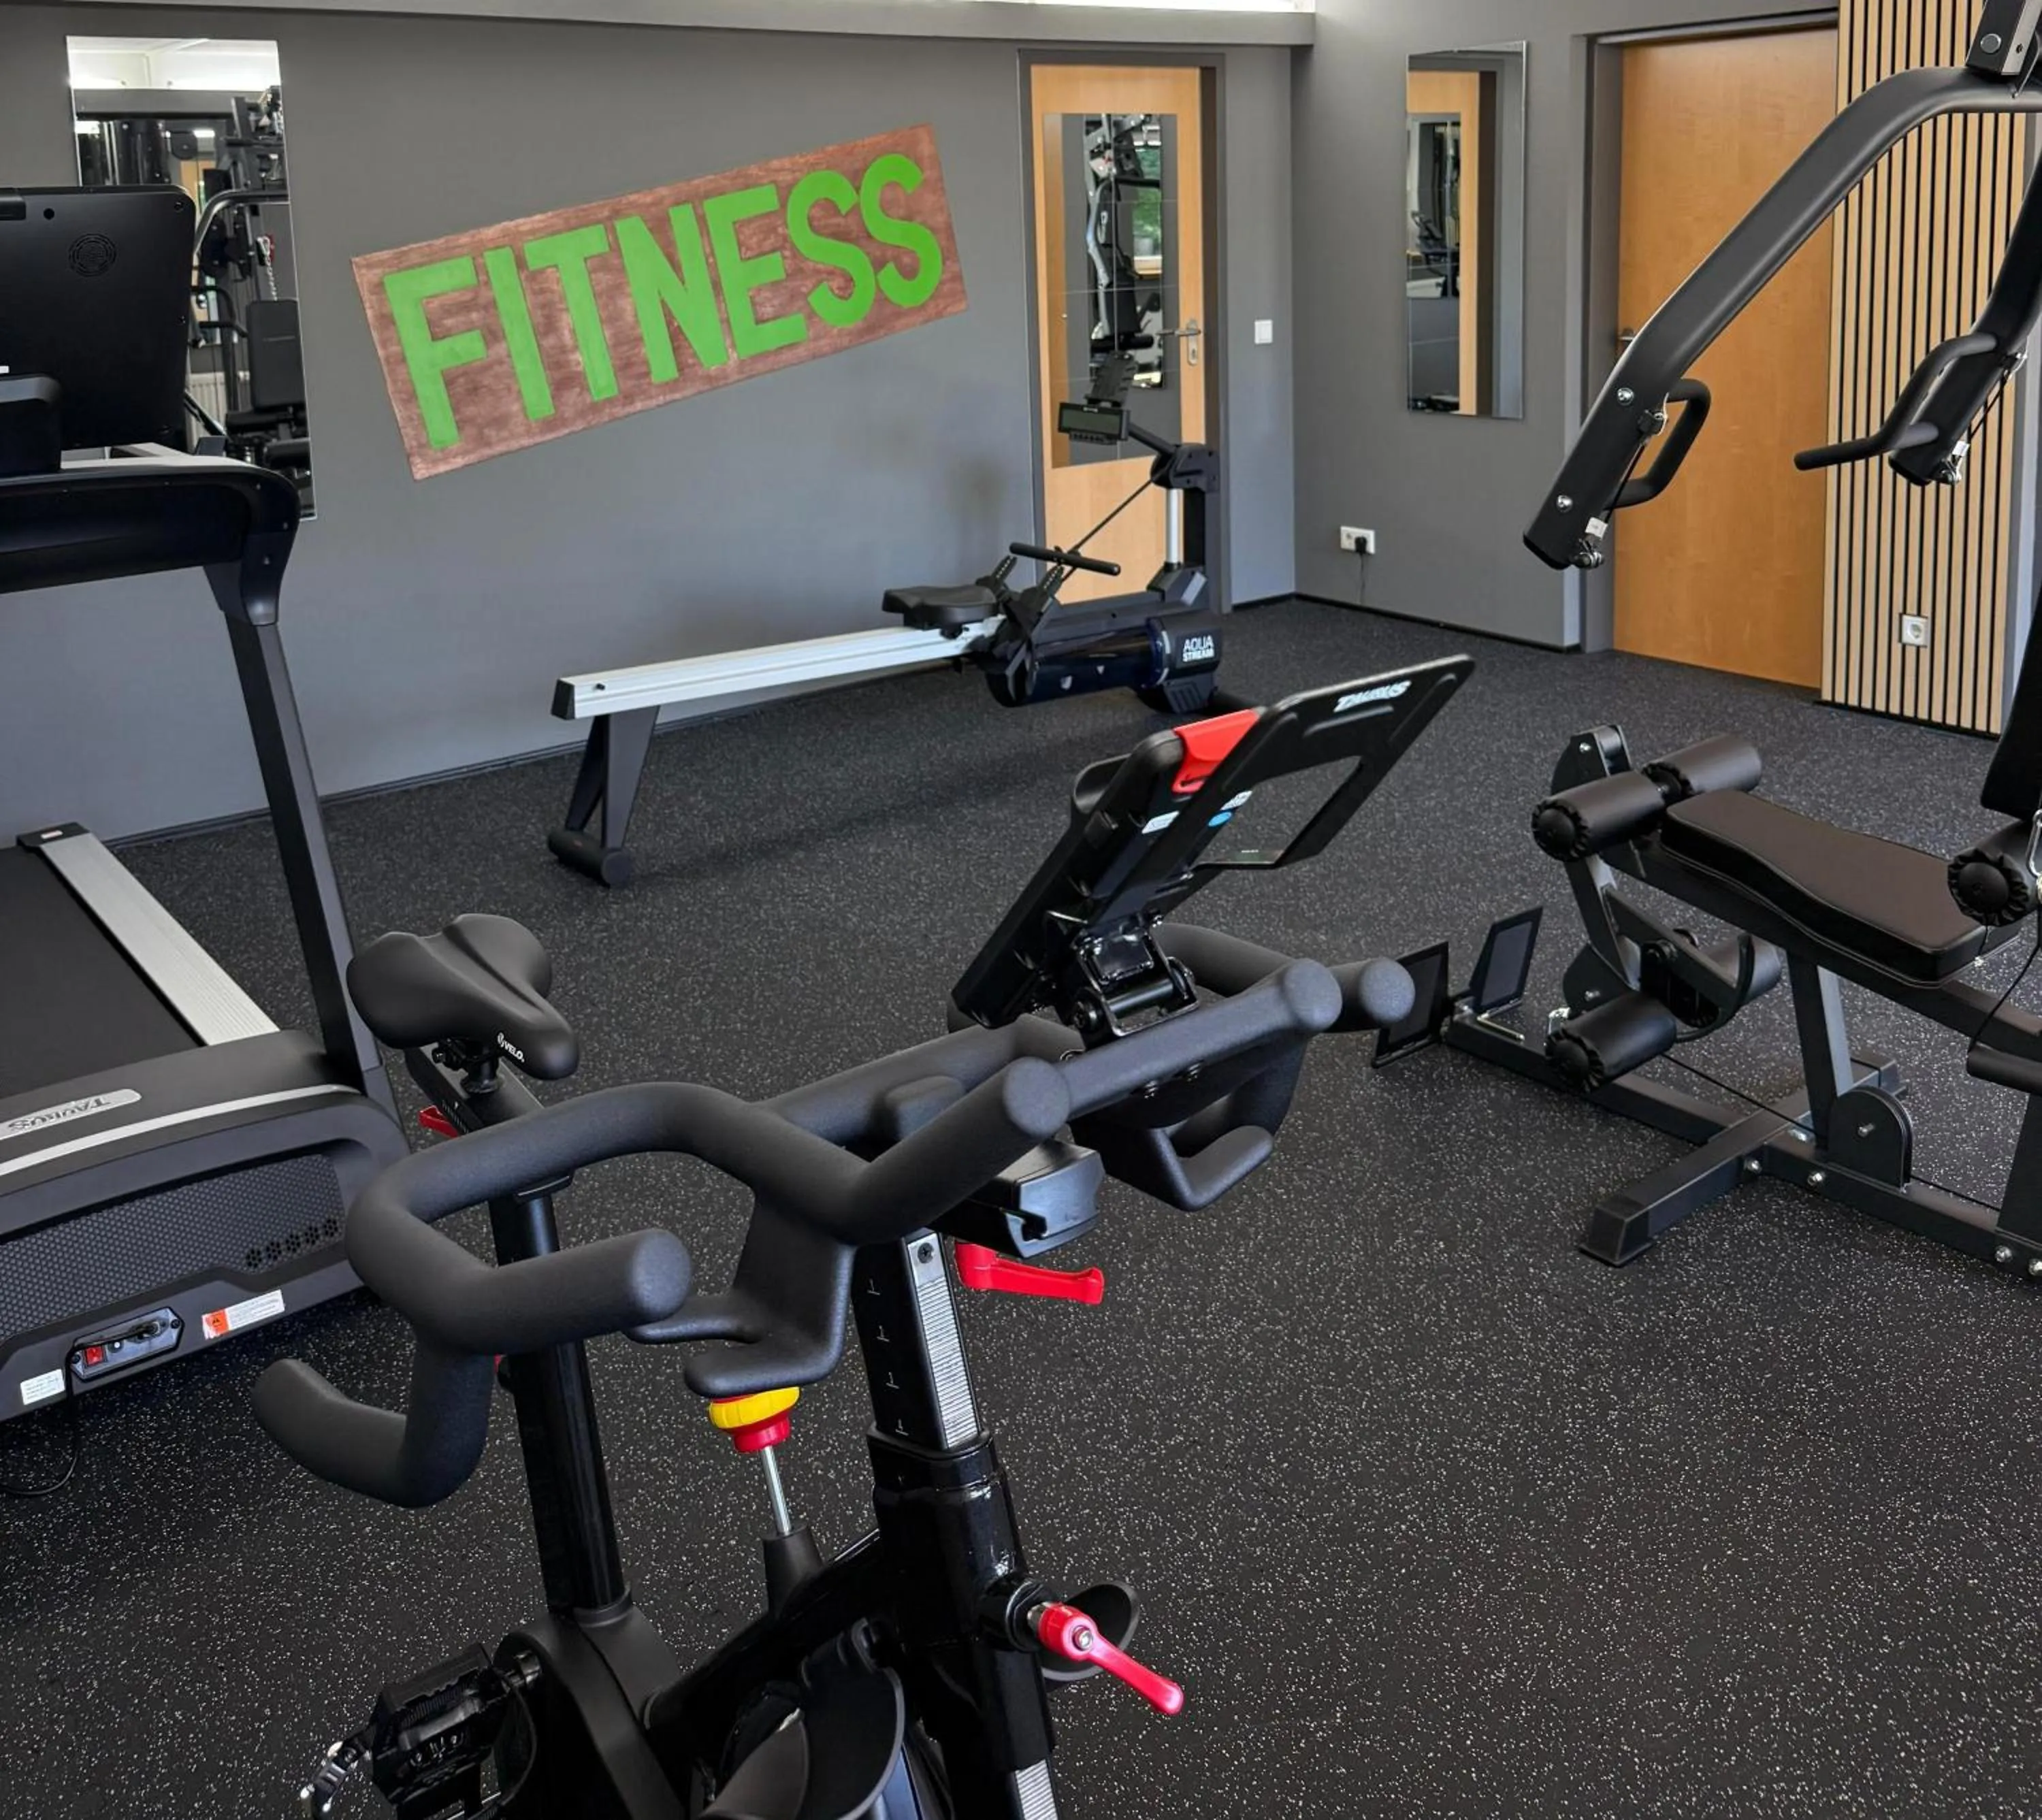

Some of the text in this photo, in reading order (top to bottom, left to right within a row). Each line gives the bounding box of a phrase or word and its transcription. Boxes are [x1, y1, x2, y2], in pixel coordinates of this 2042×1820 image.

[384, 154, 943, 451] FITNESS
[1183, 634, 1214, 653] AQUA
[7, 1096, 111, 1133] TAURUS
